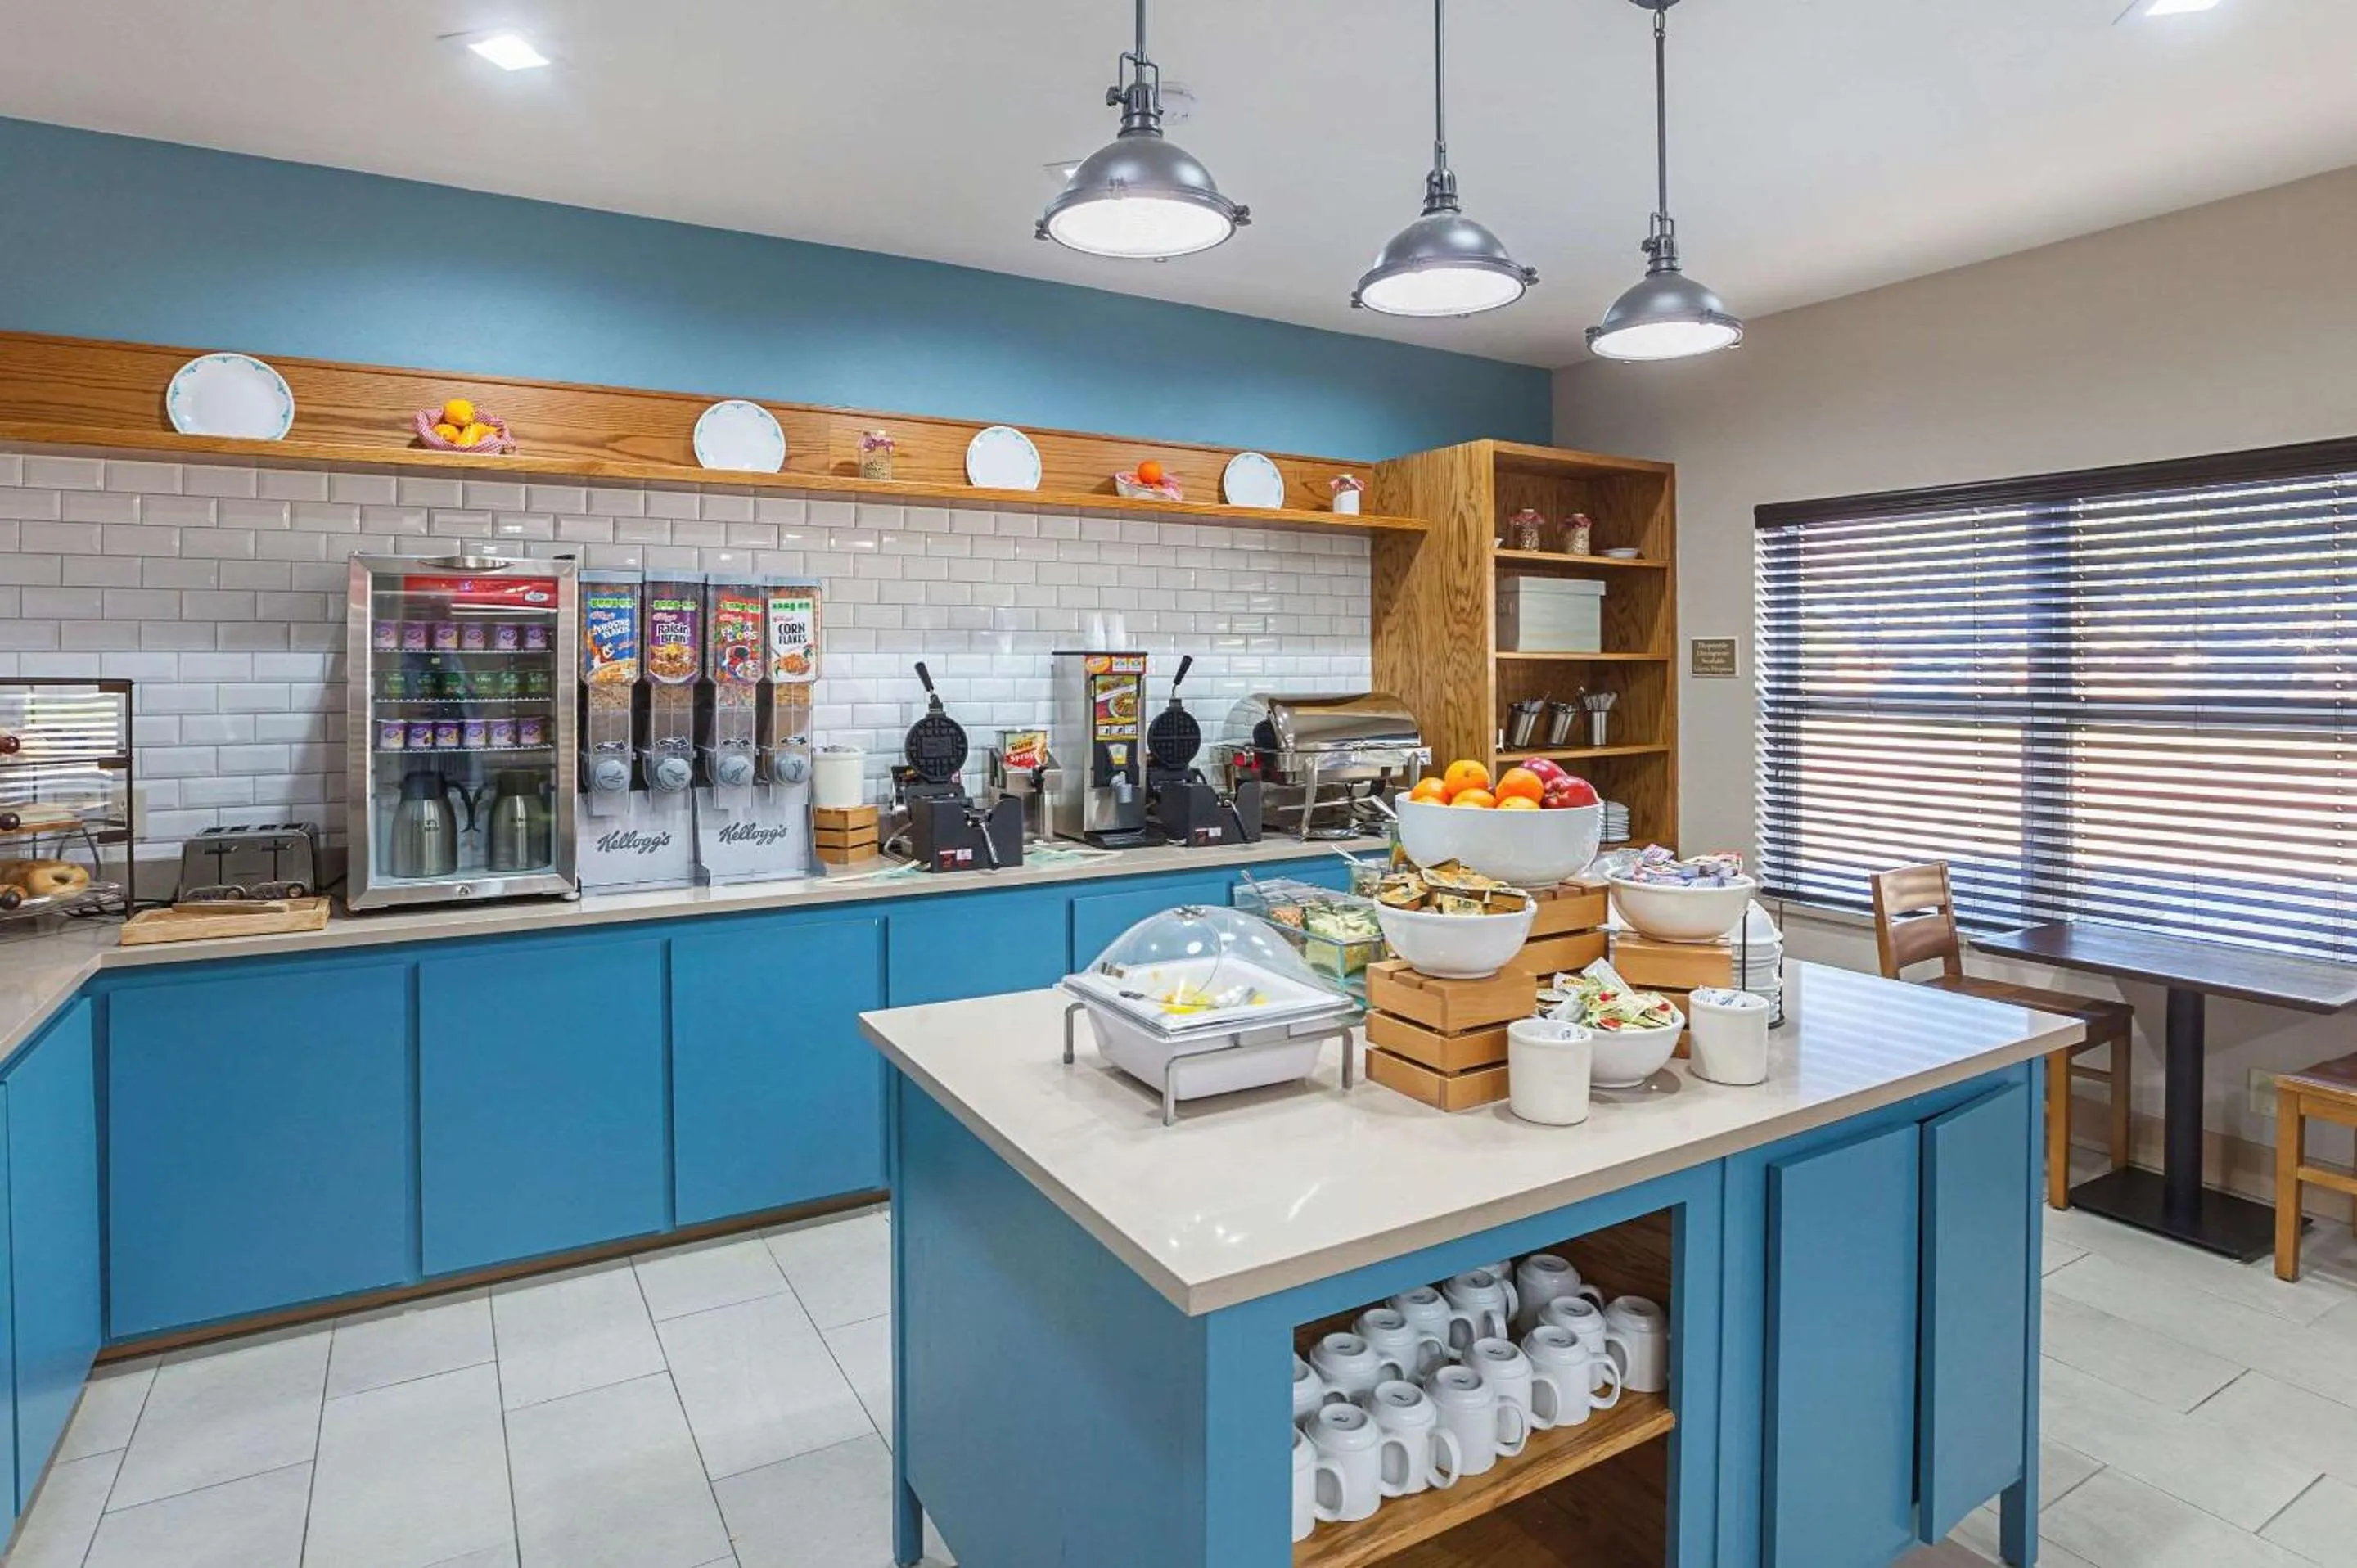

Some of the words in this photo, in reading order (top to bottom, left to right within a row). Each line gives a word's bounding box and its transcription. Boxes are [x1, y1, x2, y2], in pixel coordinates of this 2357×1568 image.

[778, 623, 806, 635] CORN
[778, 635, 807, 645] FLAKES
[597, 829, 673, 854] Kellogg's
[719, 822, 788, 845] Kellogg's
